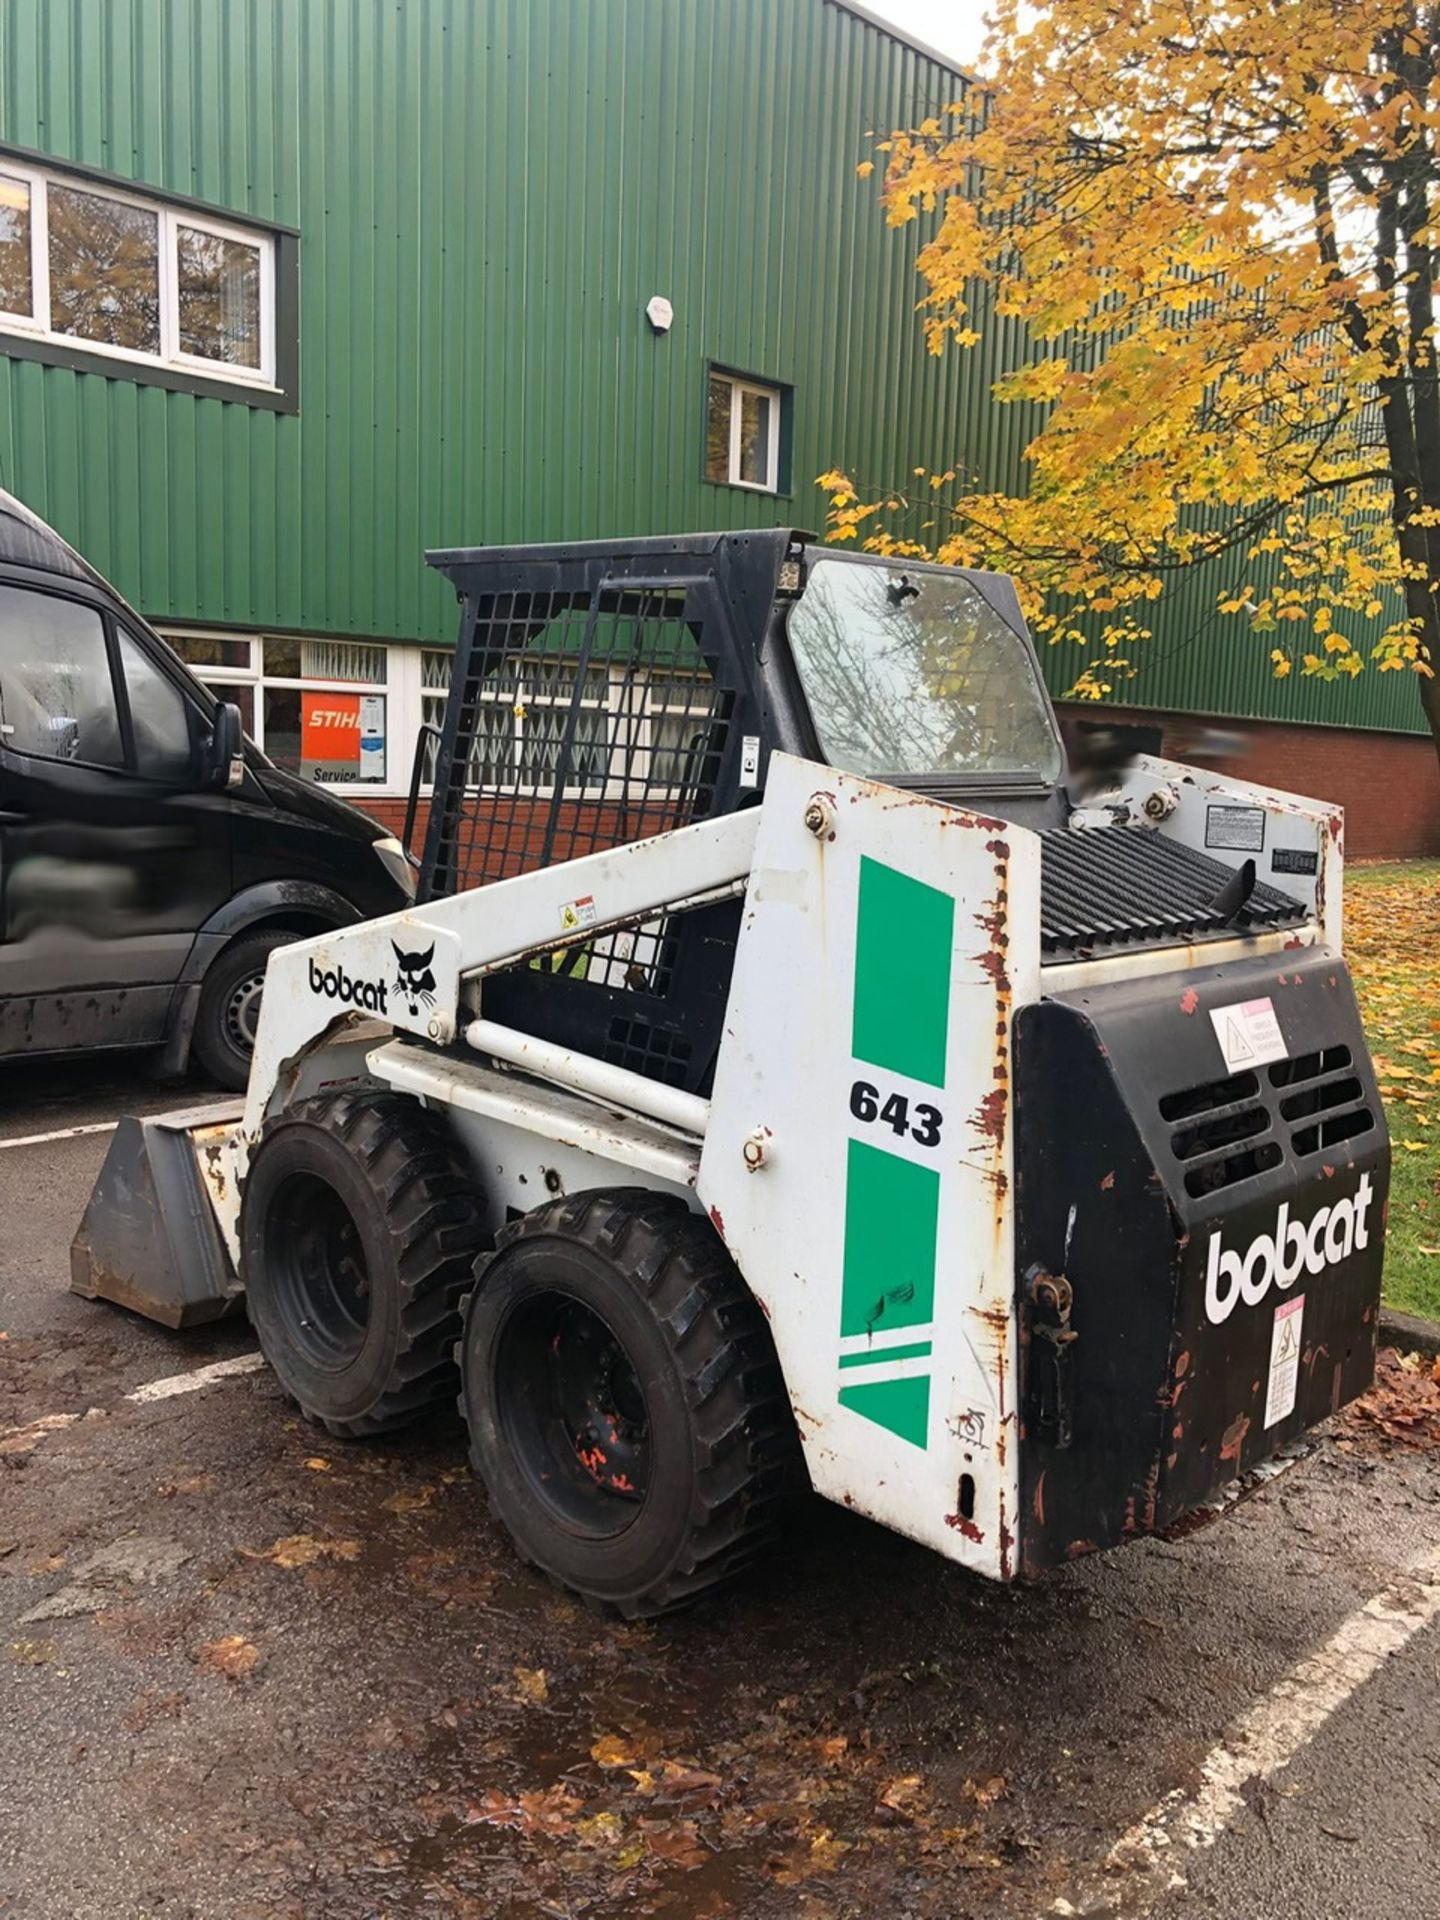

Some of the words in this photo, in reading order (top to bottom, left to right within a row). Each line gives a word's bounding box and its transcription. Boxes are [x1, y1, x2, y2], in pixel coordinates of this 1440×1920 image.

[313, 767, 357, 782] Service
[309, 957, 388, 1016] bobcat
[849, 1080, 943, 1148] 643
[1204, 1172, 1373, 1325] bobcat
